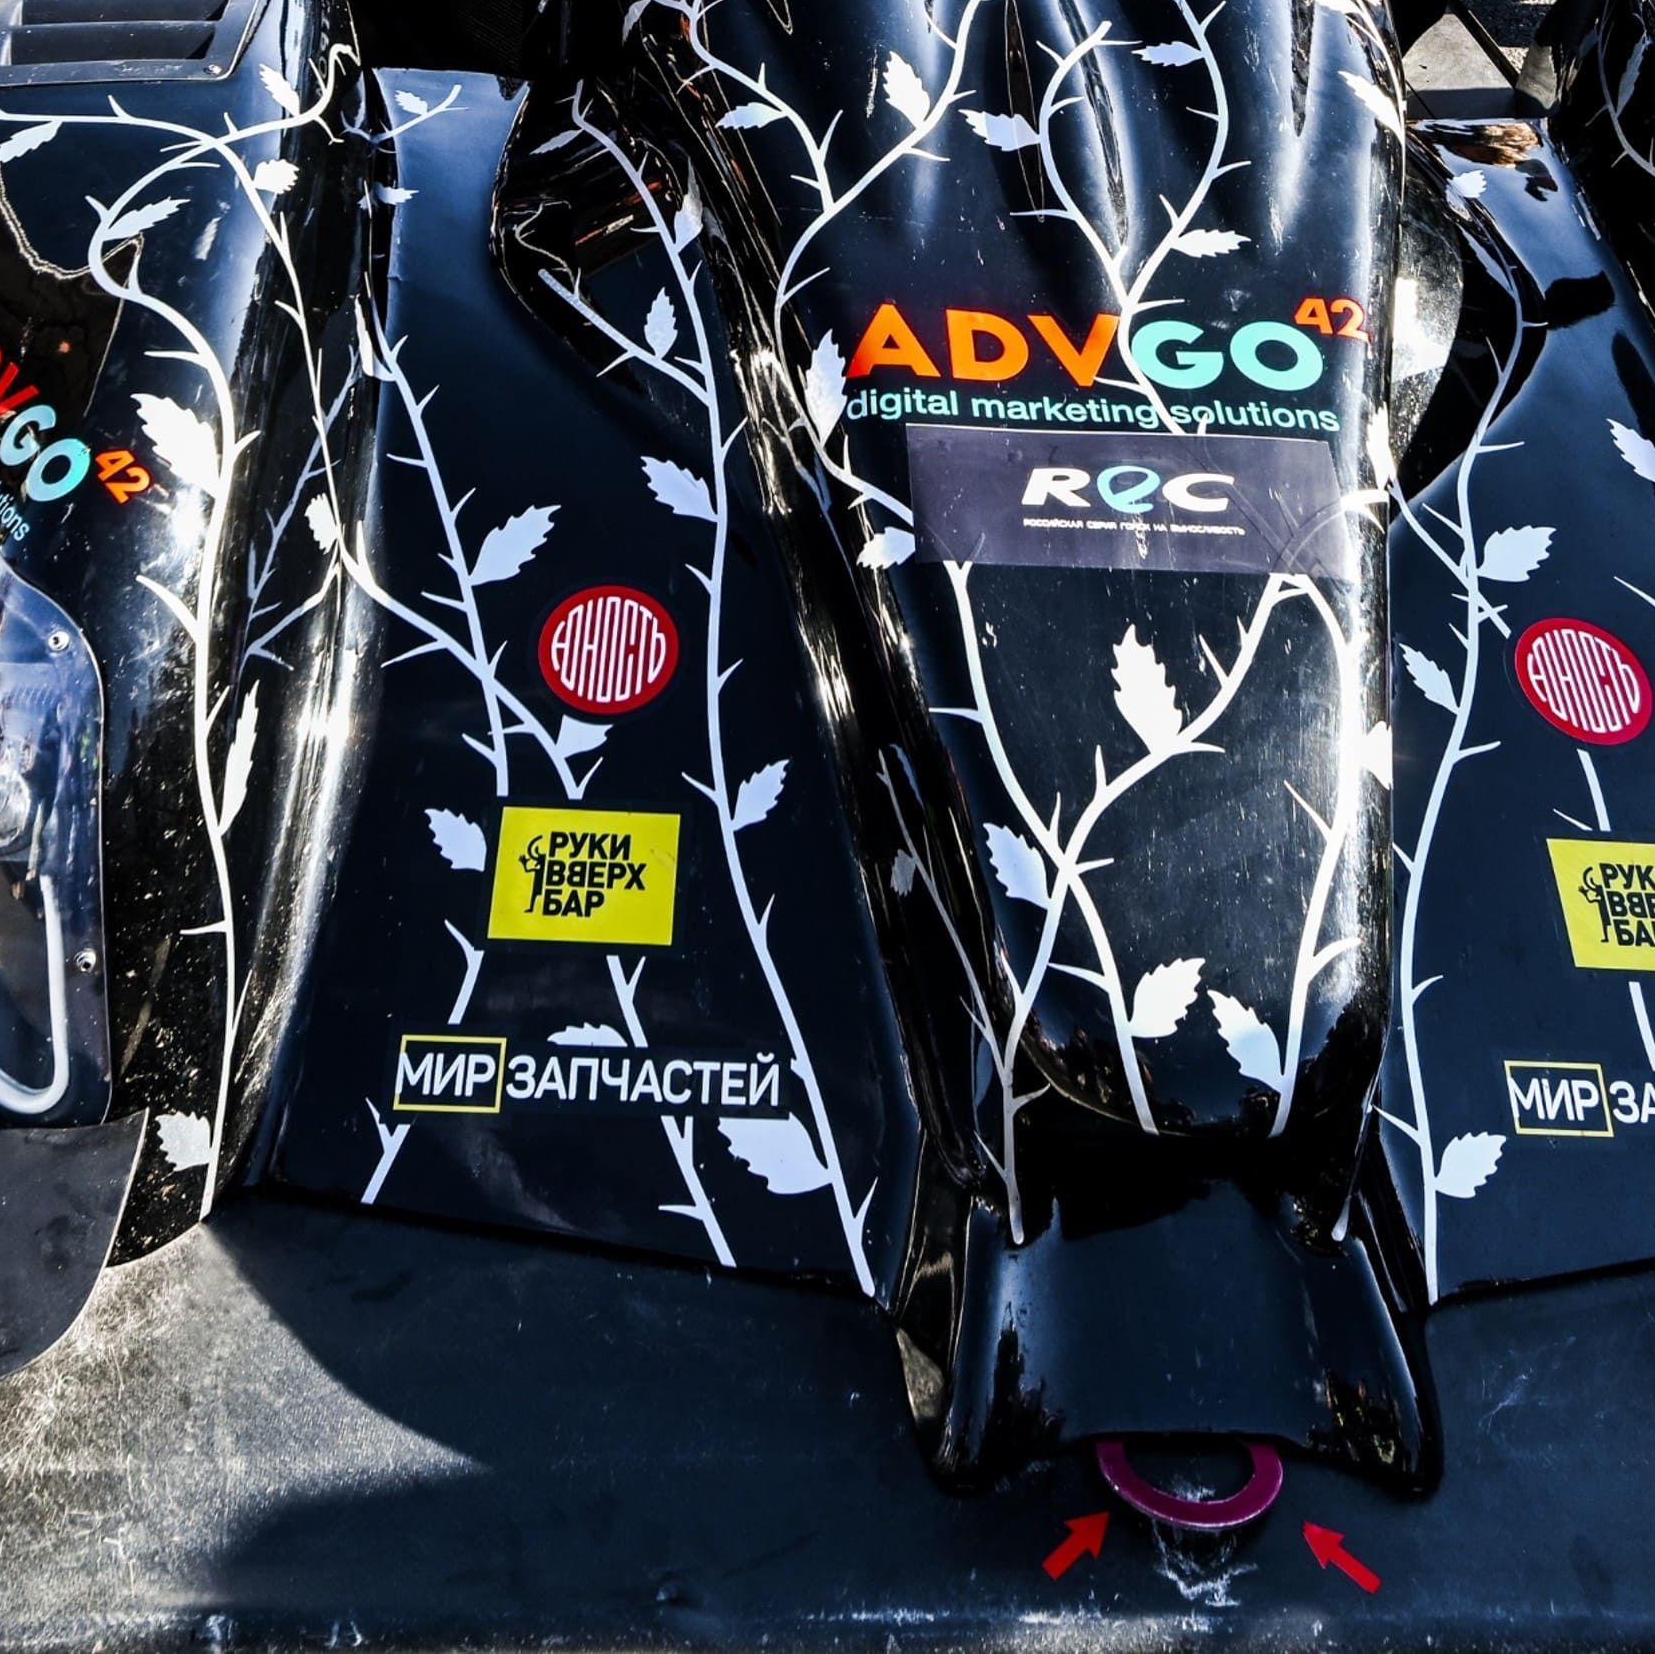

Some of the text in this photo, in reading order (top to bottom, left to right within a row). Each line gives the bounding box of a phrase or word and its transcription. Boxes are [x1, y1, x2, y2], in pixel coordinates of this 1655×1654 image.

[847, 304, 1324, 391] ADVGO
[847, 388, 1340, 432] digital marketing solutions
[1023, 517, 1083, 529] РОССИЙСКАЯ
[1087, 520, 1117, 530] СЕРИЯ
[1153, 522, 1167, 532] НА
[551, 596, 667, 703] ЮНОСТЬ
[1527, 627, 1640, 735] ЮНОСТЬ
[548, 831, 632, 860] РУКИ
[542, 890, 605, 918] БАР
[399, 1052, 781, 1106] МИР ЗАПЧАСТЕЙ
[1506, 1077, 1603, 1123] МИР
